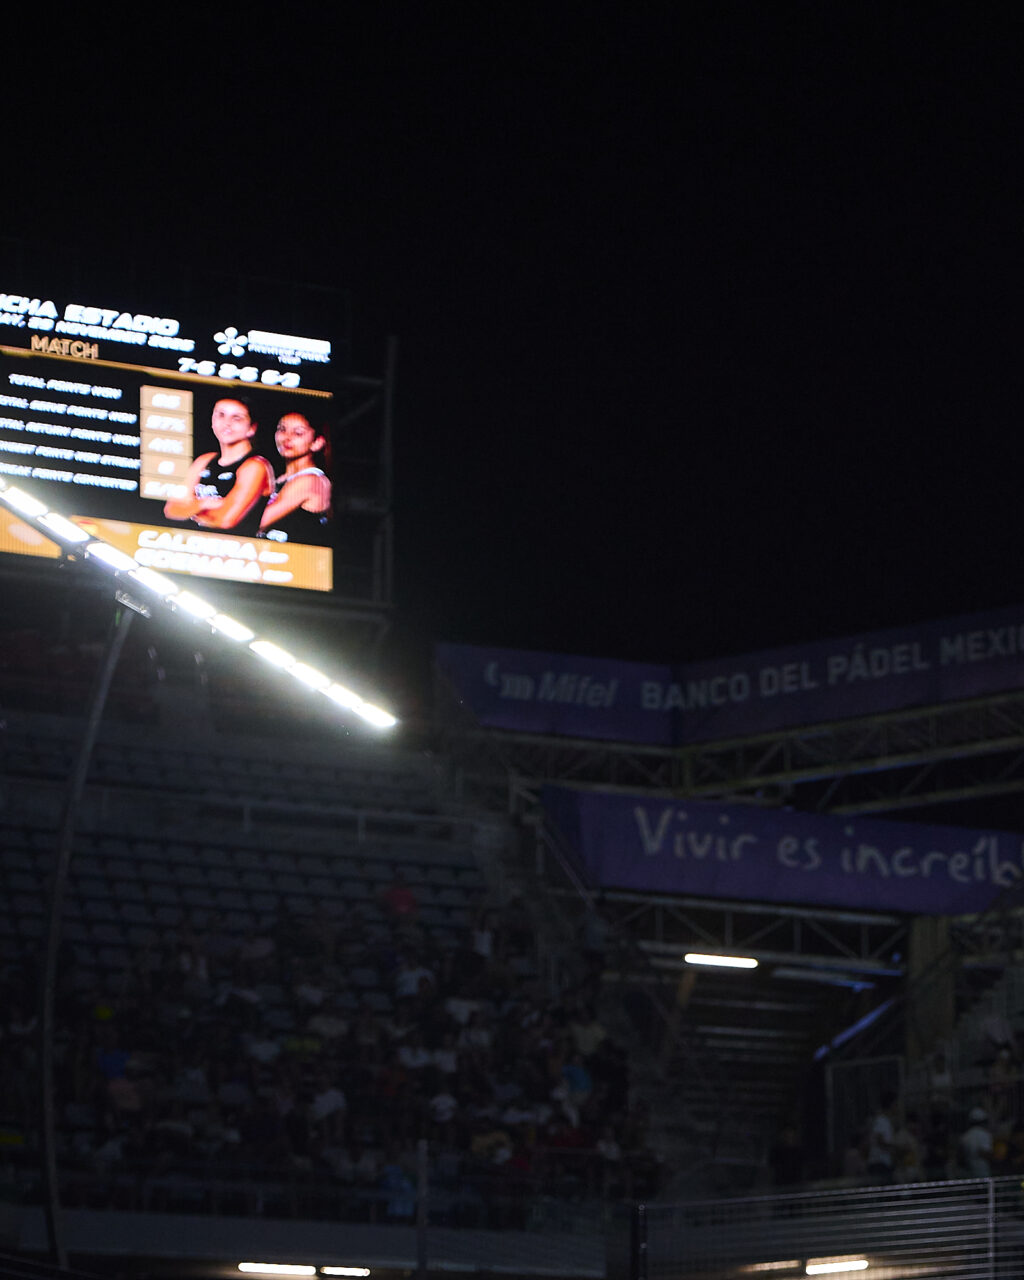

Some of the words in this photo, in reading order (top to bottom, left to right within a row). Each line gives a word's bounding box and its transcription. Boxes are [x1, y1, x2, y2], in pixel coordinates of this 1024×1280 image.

[64, 304, 179, 336] ESTADIO
[31, 335, 98, 360] MATCH
[537, 671, 619, 708] Mifel
[640, 672, 750, 710] BANCO
[759, 661, 820, 698] DEL
[827, 642, 931, 685] PÁDEL
[634, 806, 758, 861] Vivir
[778, 836, 822, 871] es
